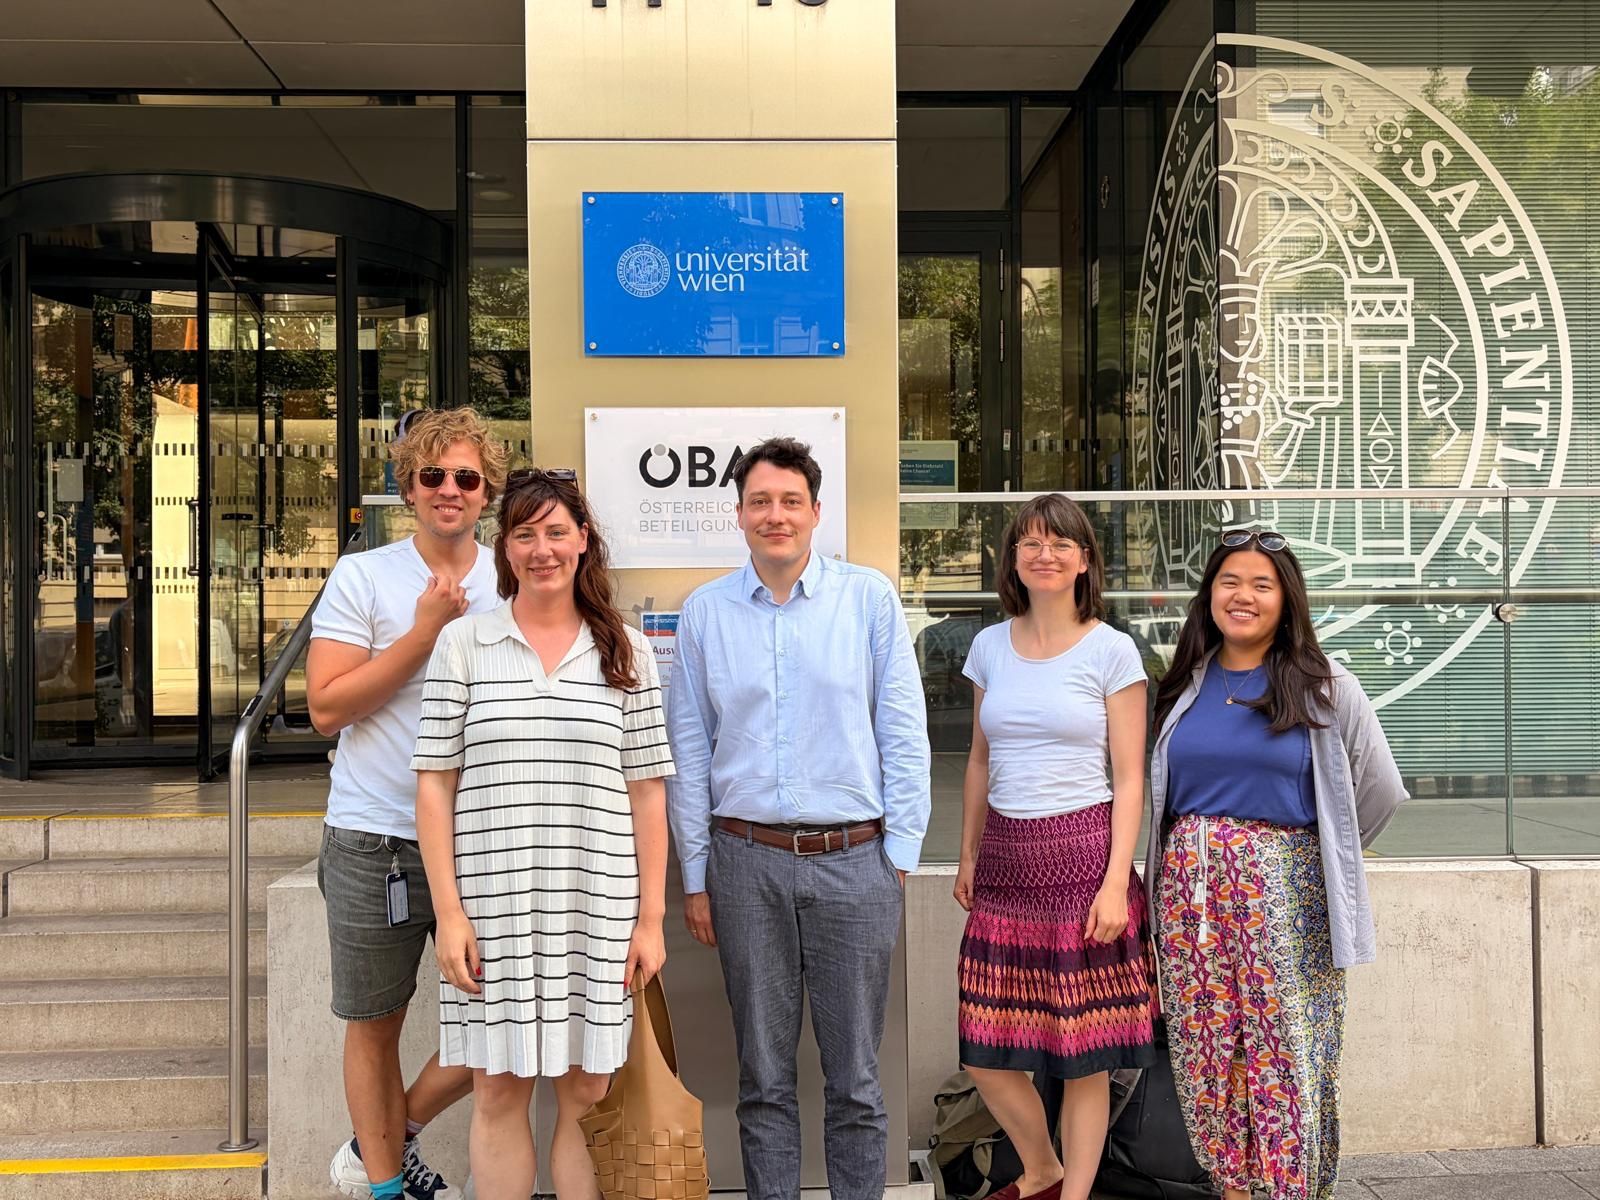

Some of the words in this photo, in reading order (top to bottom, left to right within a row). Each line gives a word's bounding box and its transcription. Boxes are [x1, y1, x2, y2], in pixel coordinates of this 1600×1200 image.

[675, 245, 810, 272] universität
[677, 272, 745, 292] wien
[638, 498, 738, 514] ÖSTERREIC
